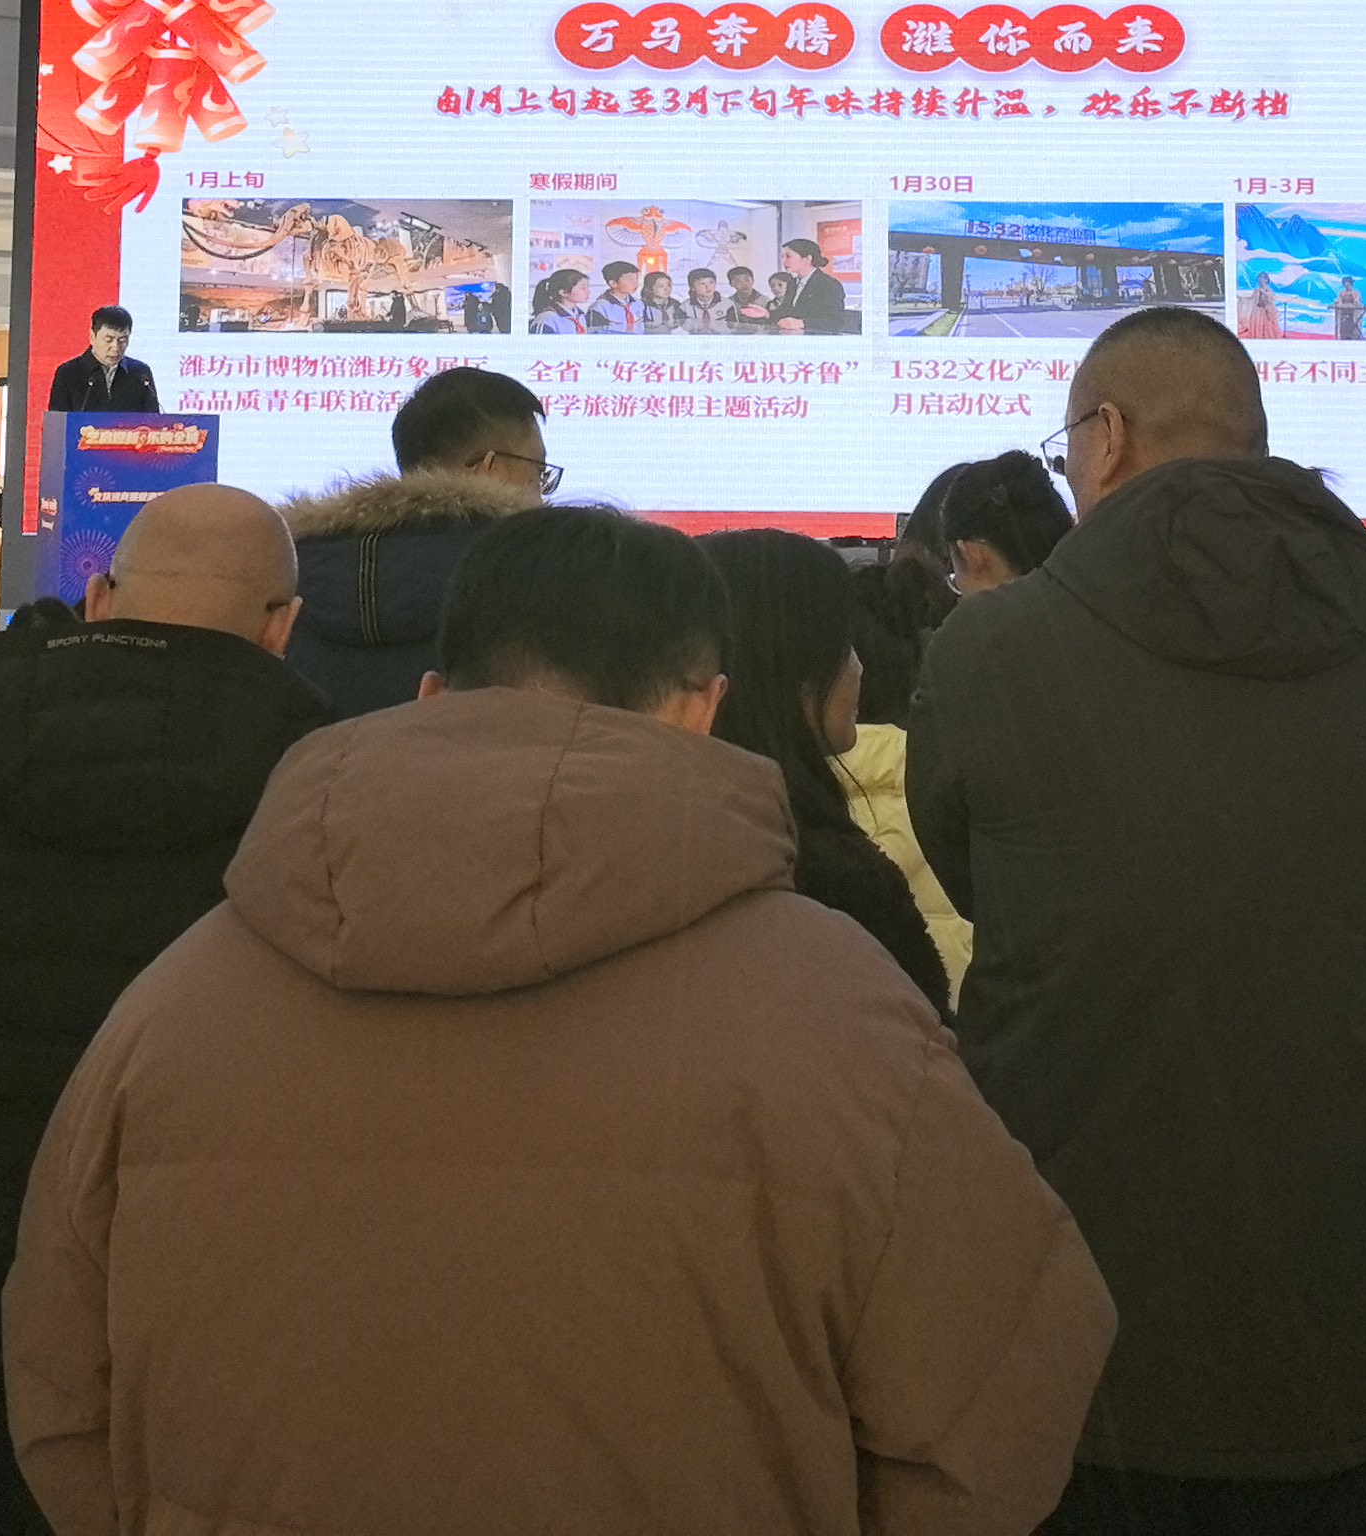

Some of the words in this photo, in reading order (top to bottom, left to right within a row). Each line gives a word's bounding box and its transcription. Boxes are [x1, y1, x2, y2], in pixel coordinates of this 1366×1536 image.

[580, 13, 838, 56] 万马奔腾
[901, 15, 1164, 57] 潍你而来
[186, 171, 265, 189] 1月上旬
[529, 173, 618, 191] 寒假期间
[890, 175, 974, 193] 1月30日
[1233, 177, 1315, 195] 1月-3月
[891, 358, 1082, 382] 1532文化产业
[892, 393, 1031, 416] 月启动仪式
